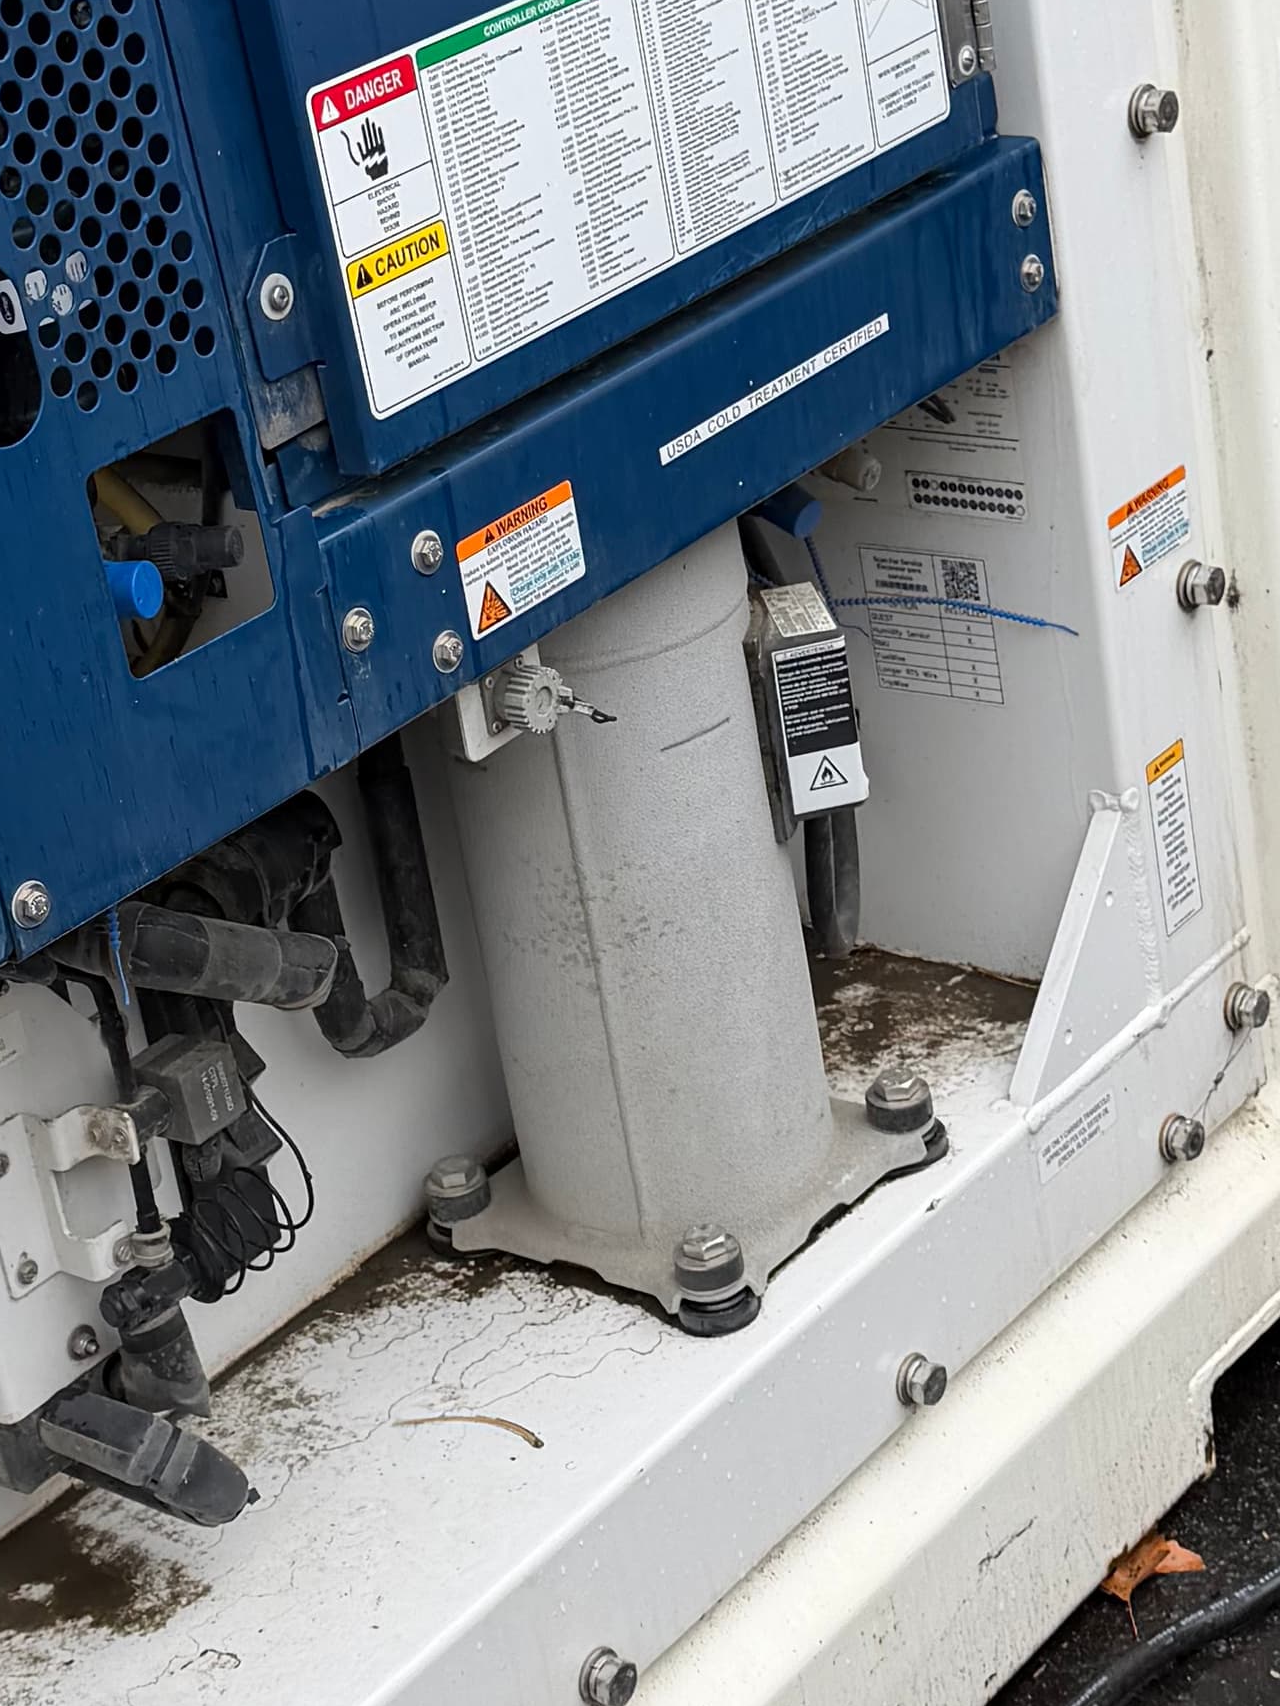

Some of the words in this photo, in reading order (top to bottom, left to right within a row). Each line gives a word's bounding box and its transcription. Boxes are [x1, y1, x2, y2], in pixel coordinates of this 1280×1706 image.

[483, 5, 536, 38] CONTROLLER
[344, 67, 403, 111] DANGER
[374, 230, 440, 278] CAUTION
[667, 430, 701, 458] USDA
[707, 405, 741, 434] COLD
[747, 359, 818, 410] TREATMENT
[823, 320, 882, 364] CERTIFIED
[495, 496, 548, 537] WARNING
